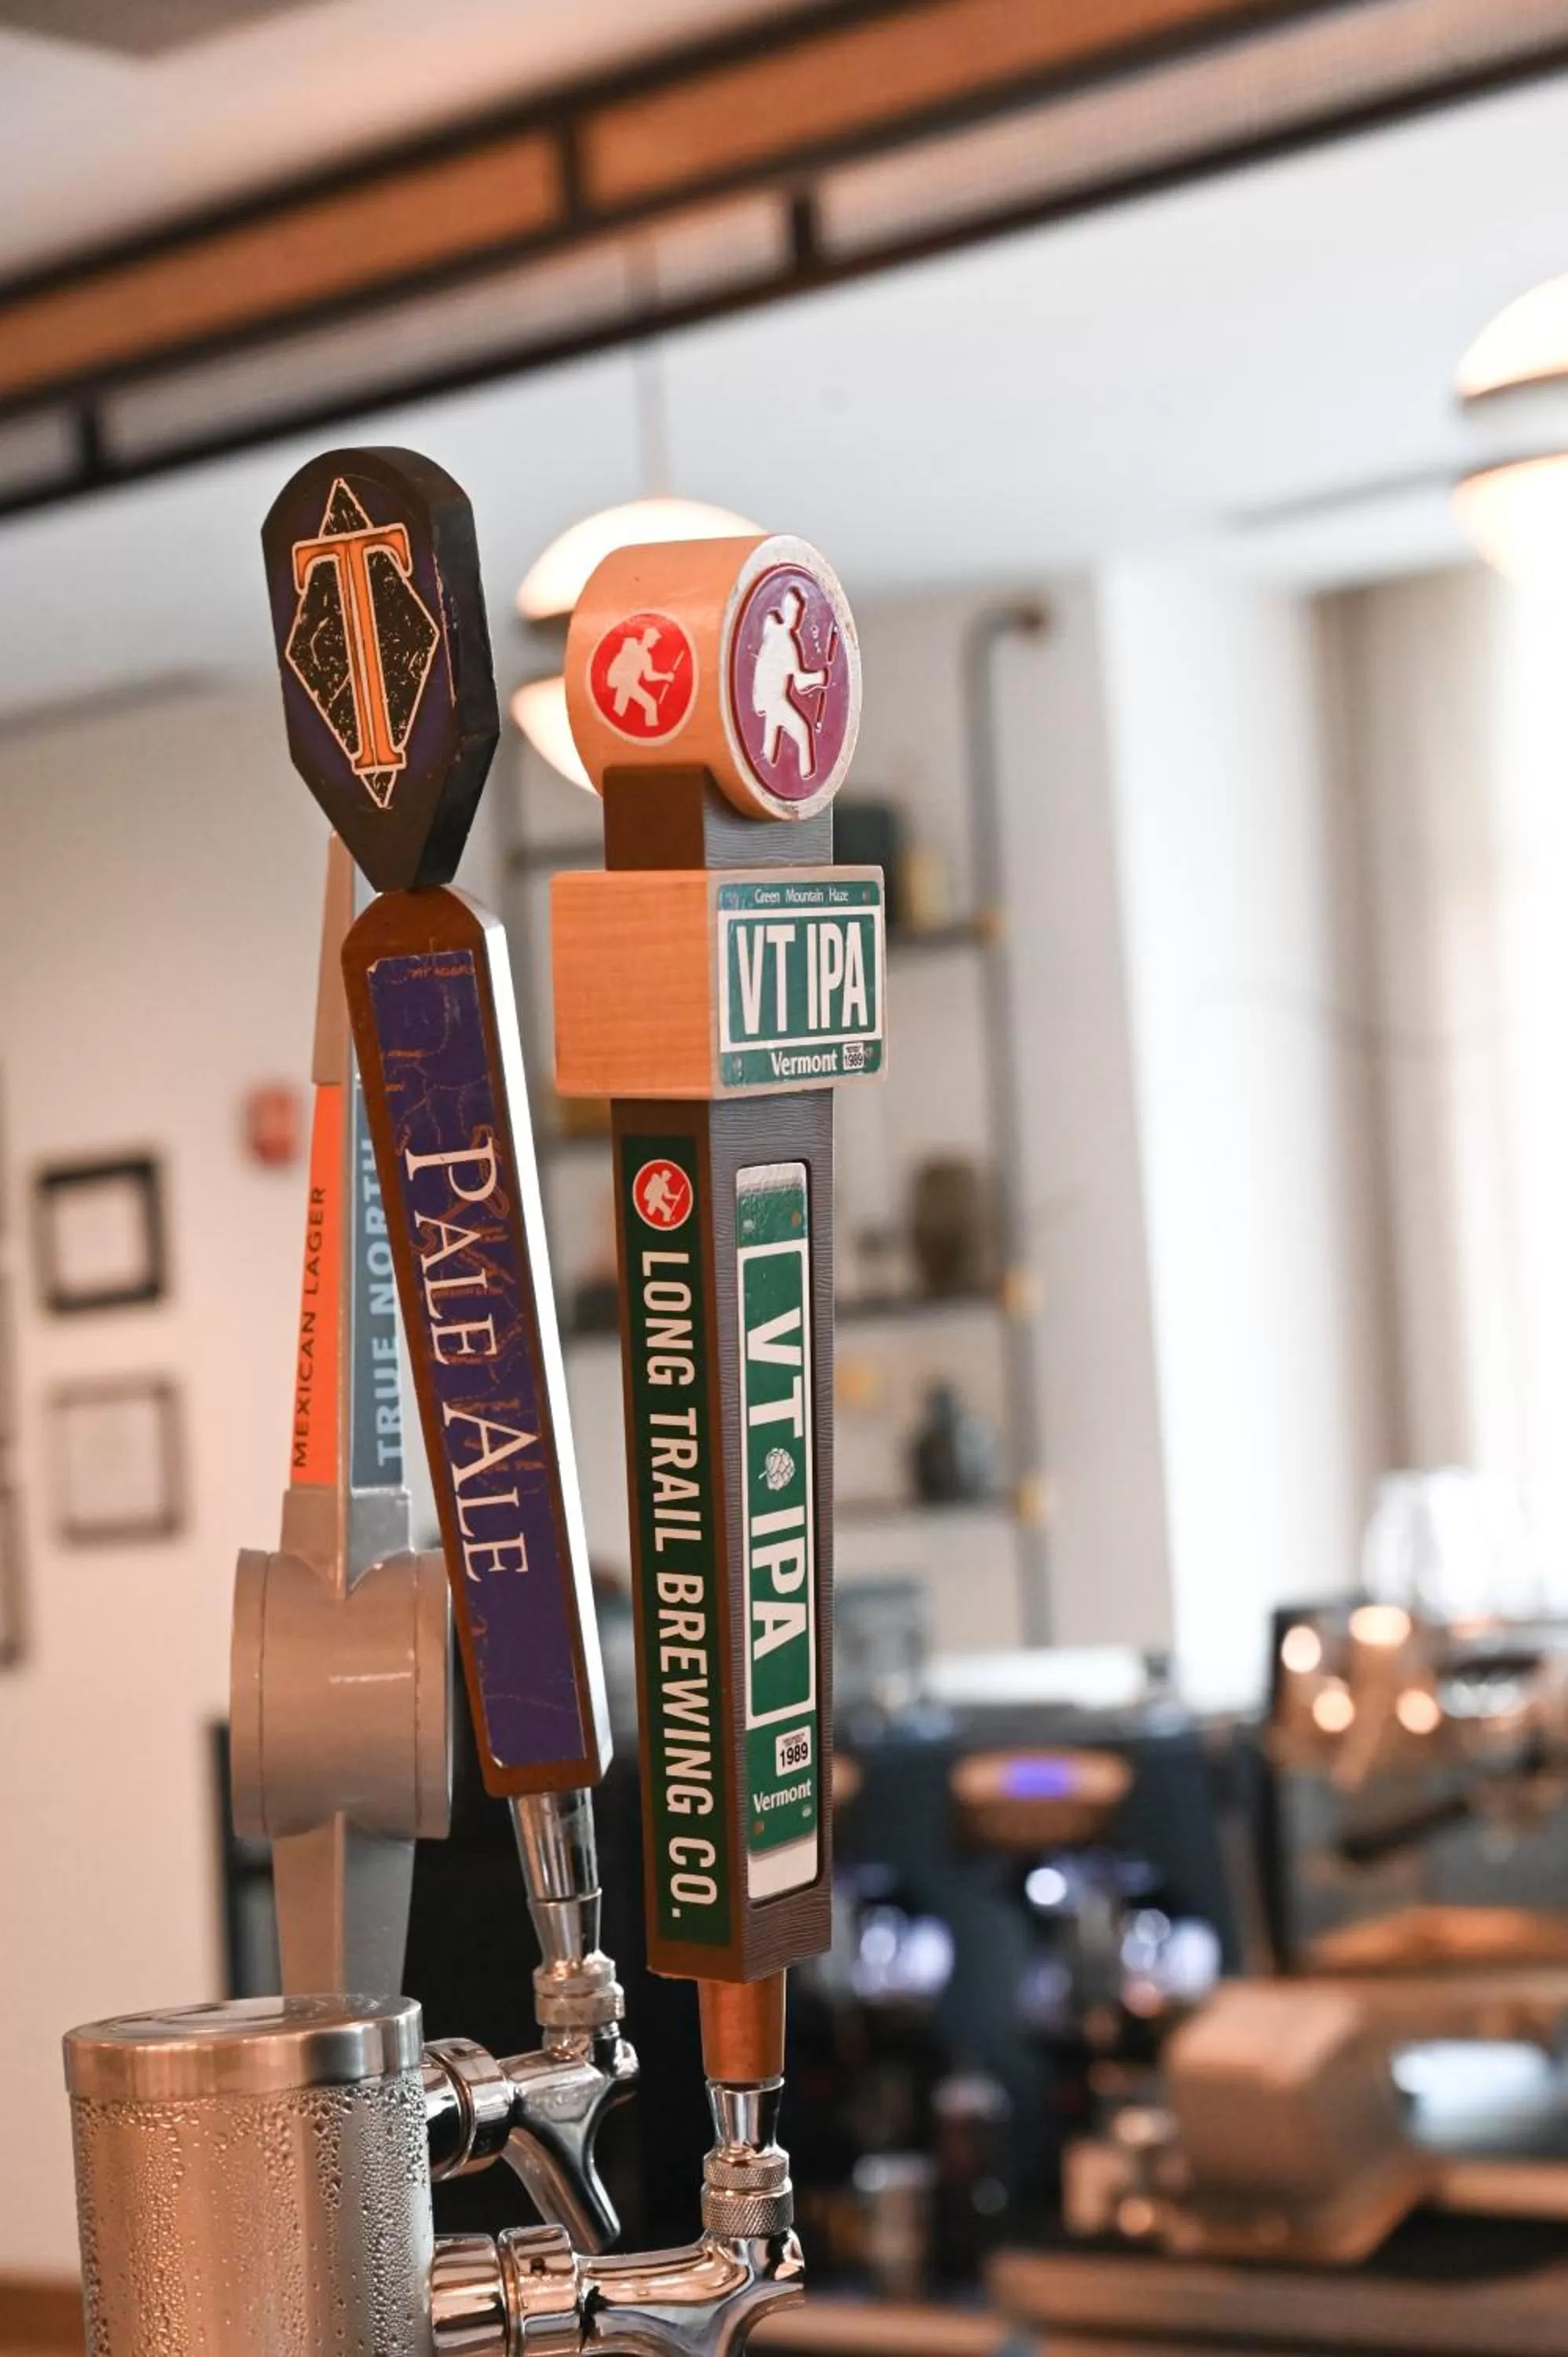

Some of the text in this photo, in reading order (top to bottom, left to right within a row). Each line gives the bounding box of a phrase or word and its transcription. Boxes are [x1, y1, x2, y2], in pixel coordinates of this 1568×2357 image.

[291, 522, 413, 775] T
[754, 888, 780, 904] Green
[786, 886, 823, 904] Mountain
[737, 922, 868, 1035] VT IPA
[771, 1049, 838, 1076] Vermont
[293, 1186, 326, 1468] MEXICAN LAGER
[405, 1137, 539, 1582] PALE ALE
[372, 1336, 402, 1467] TRUE
[747, 1307, 807, 1661] VT IPA
[641, 1250, 718, 1918] LONG TRAIL BREWING CO.
[753, 1779, 811, 1813] Vermont
[780, 1742, 808, 1769] 1989
